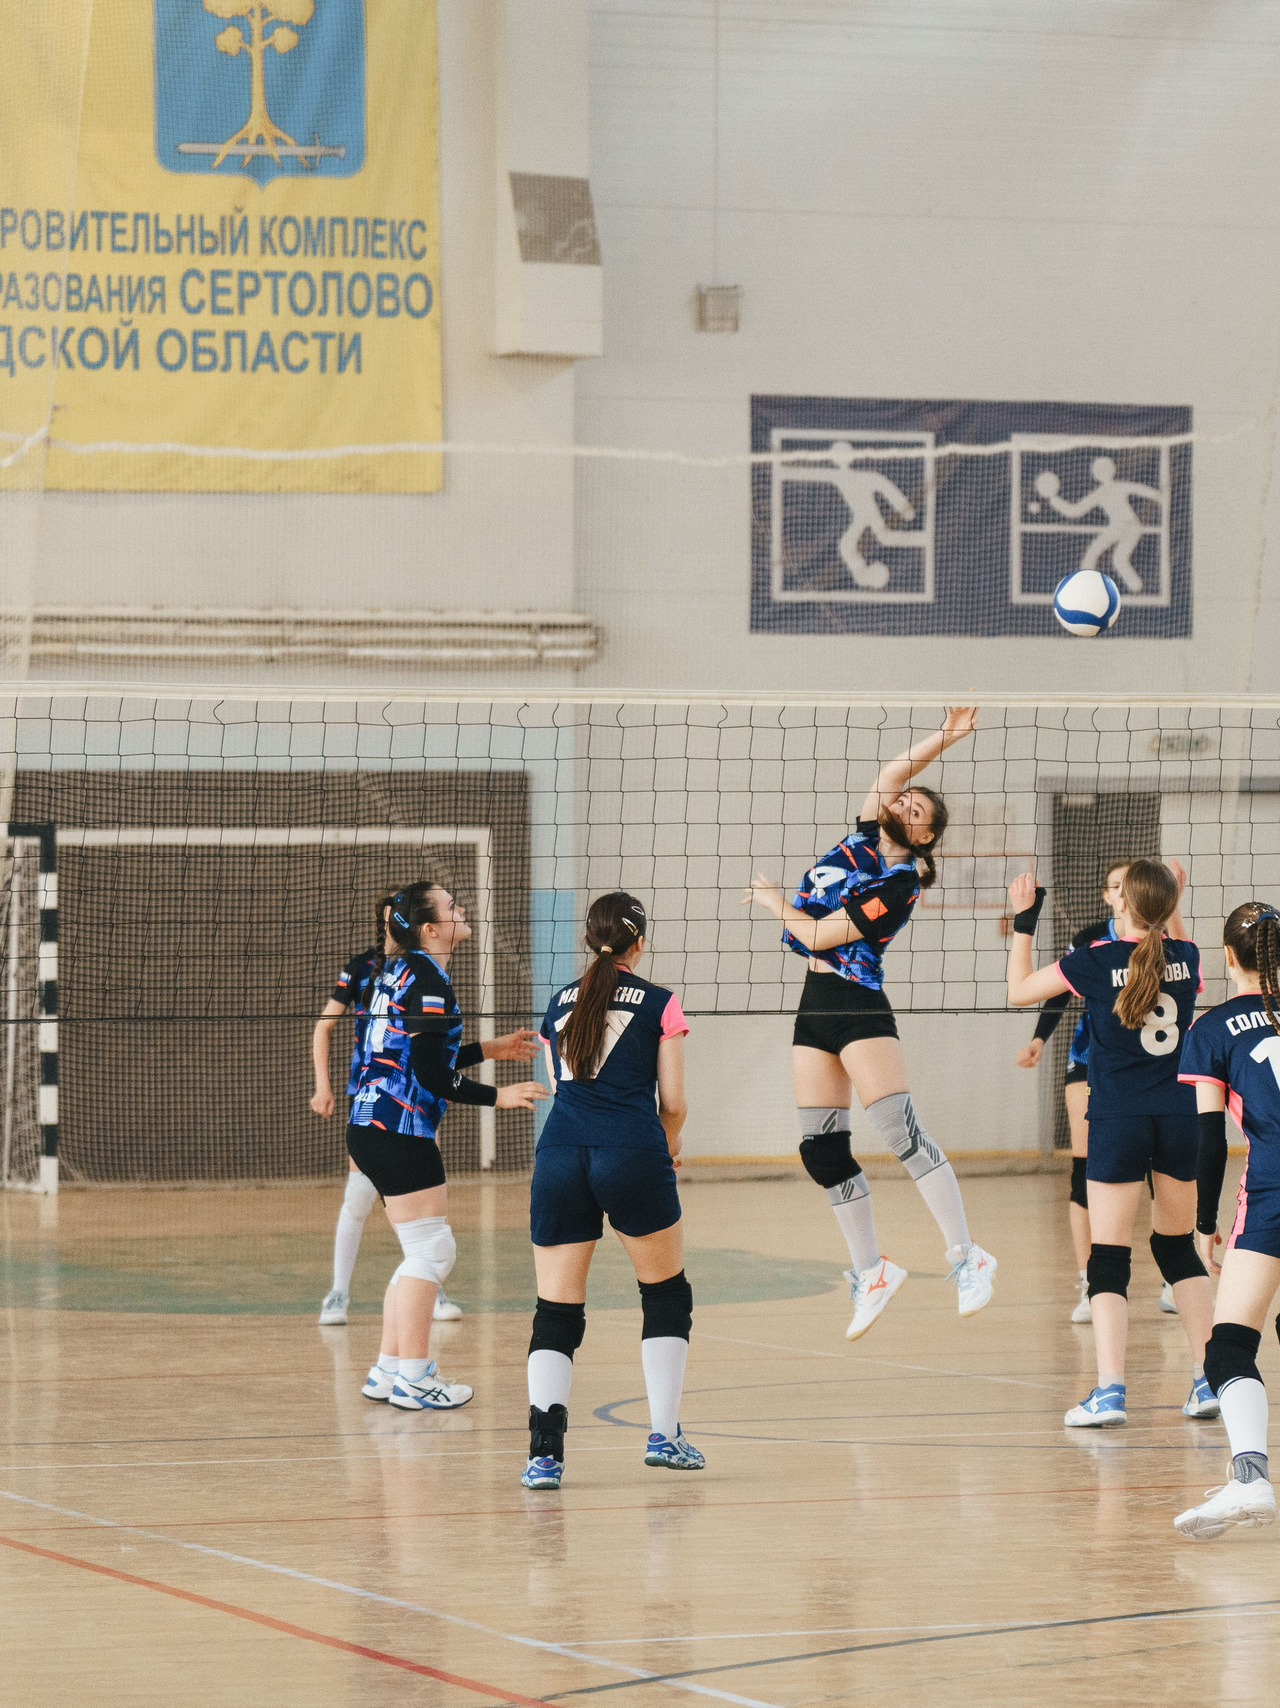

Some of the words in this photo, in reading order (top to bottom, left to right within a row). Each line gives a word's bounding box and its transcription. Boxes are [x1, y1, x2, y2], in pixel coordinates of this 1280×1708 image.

[0, 206, 249, 256] РОВИТЕЛЬНЫЙ
[259, 214, 428, 261] КОМПЛЕКС
[0, 272, 166, 314] АЗОВАНИЯ
[180, 268, 434, 318] СЕРТОЛОВО
[156, 328, 363, 375] ОБЛАСТИ
[1140, 992, 1180, 1057] 8
